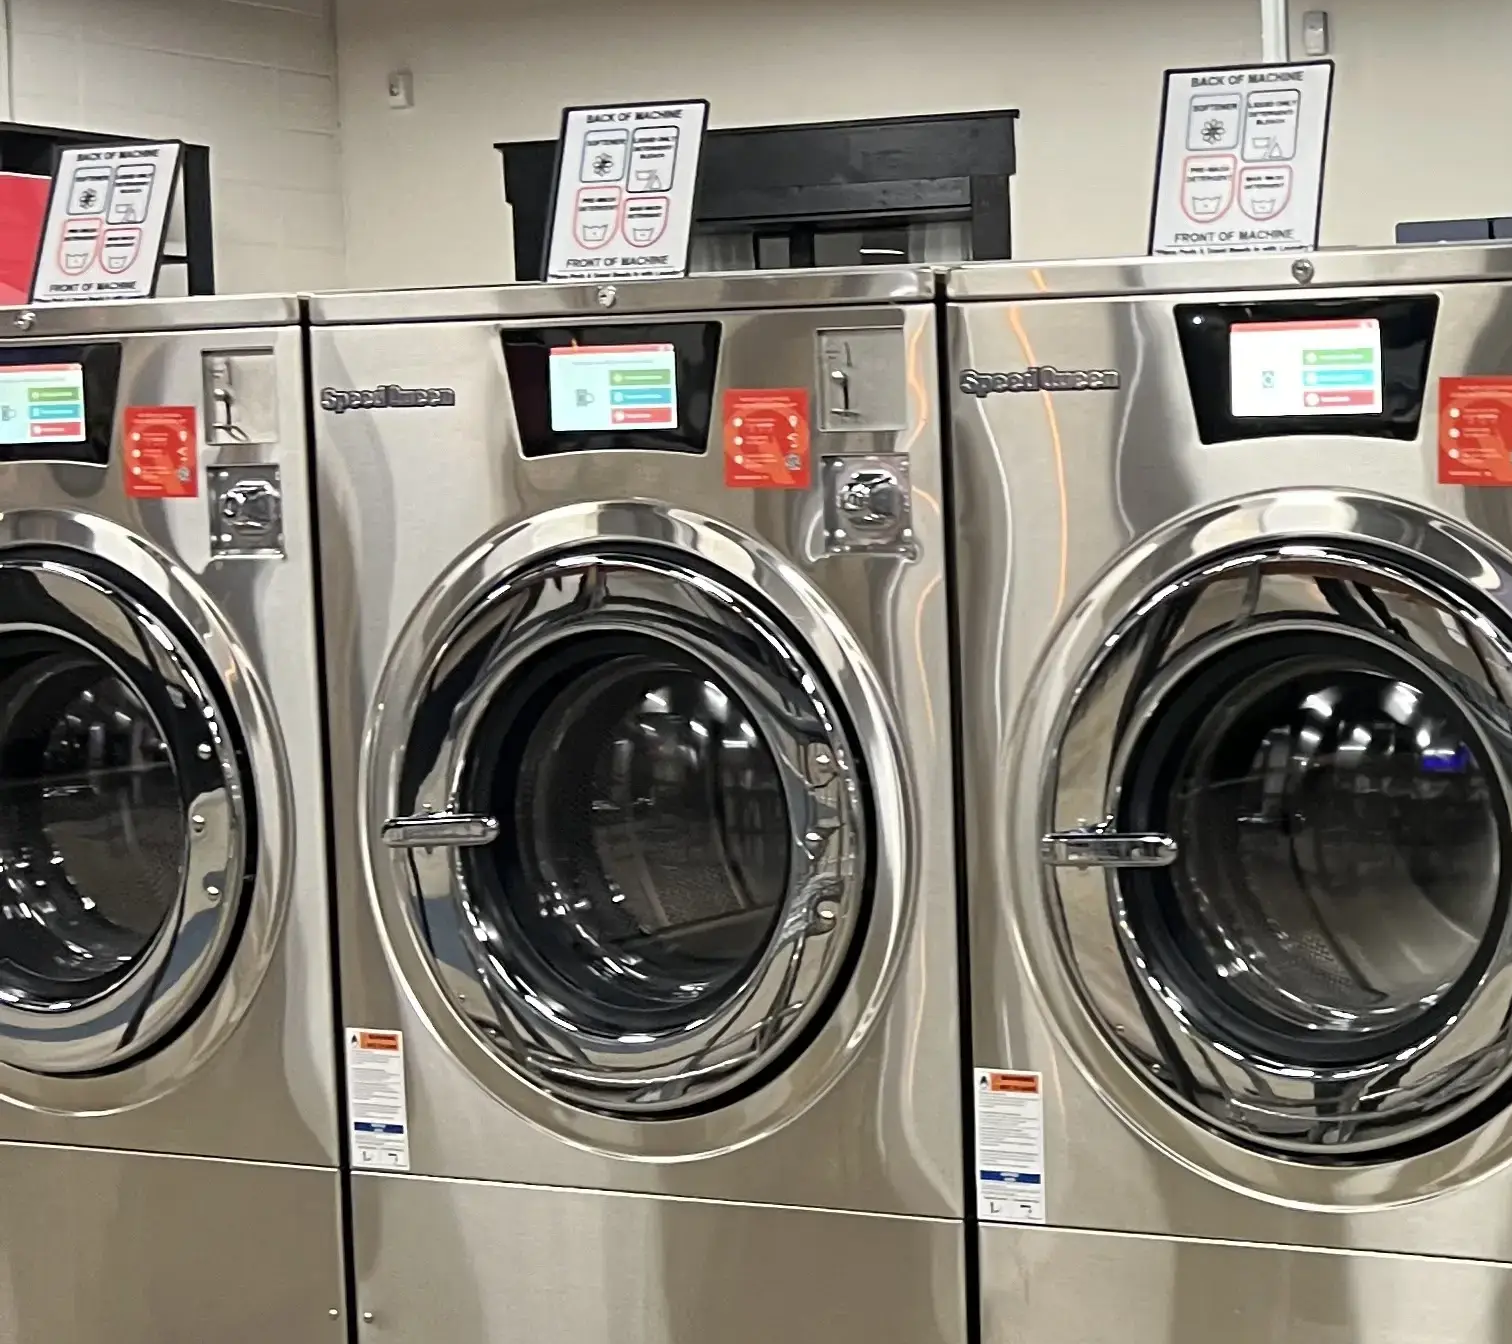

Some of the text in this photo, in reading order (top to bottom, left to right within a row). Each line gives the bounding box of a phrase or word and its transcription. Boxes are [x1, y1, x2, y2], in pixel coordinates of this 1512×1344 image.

[1191, 71, 1304, 87] BACK OF MACHINE
[1174, 229, 1294, 243] FRONT OF MACHINE
[960, 365, 1121, 398] Speed Queen
[321, 385, 387, 414] Speed
